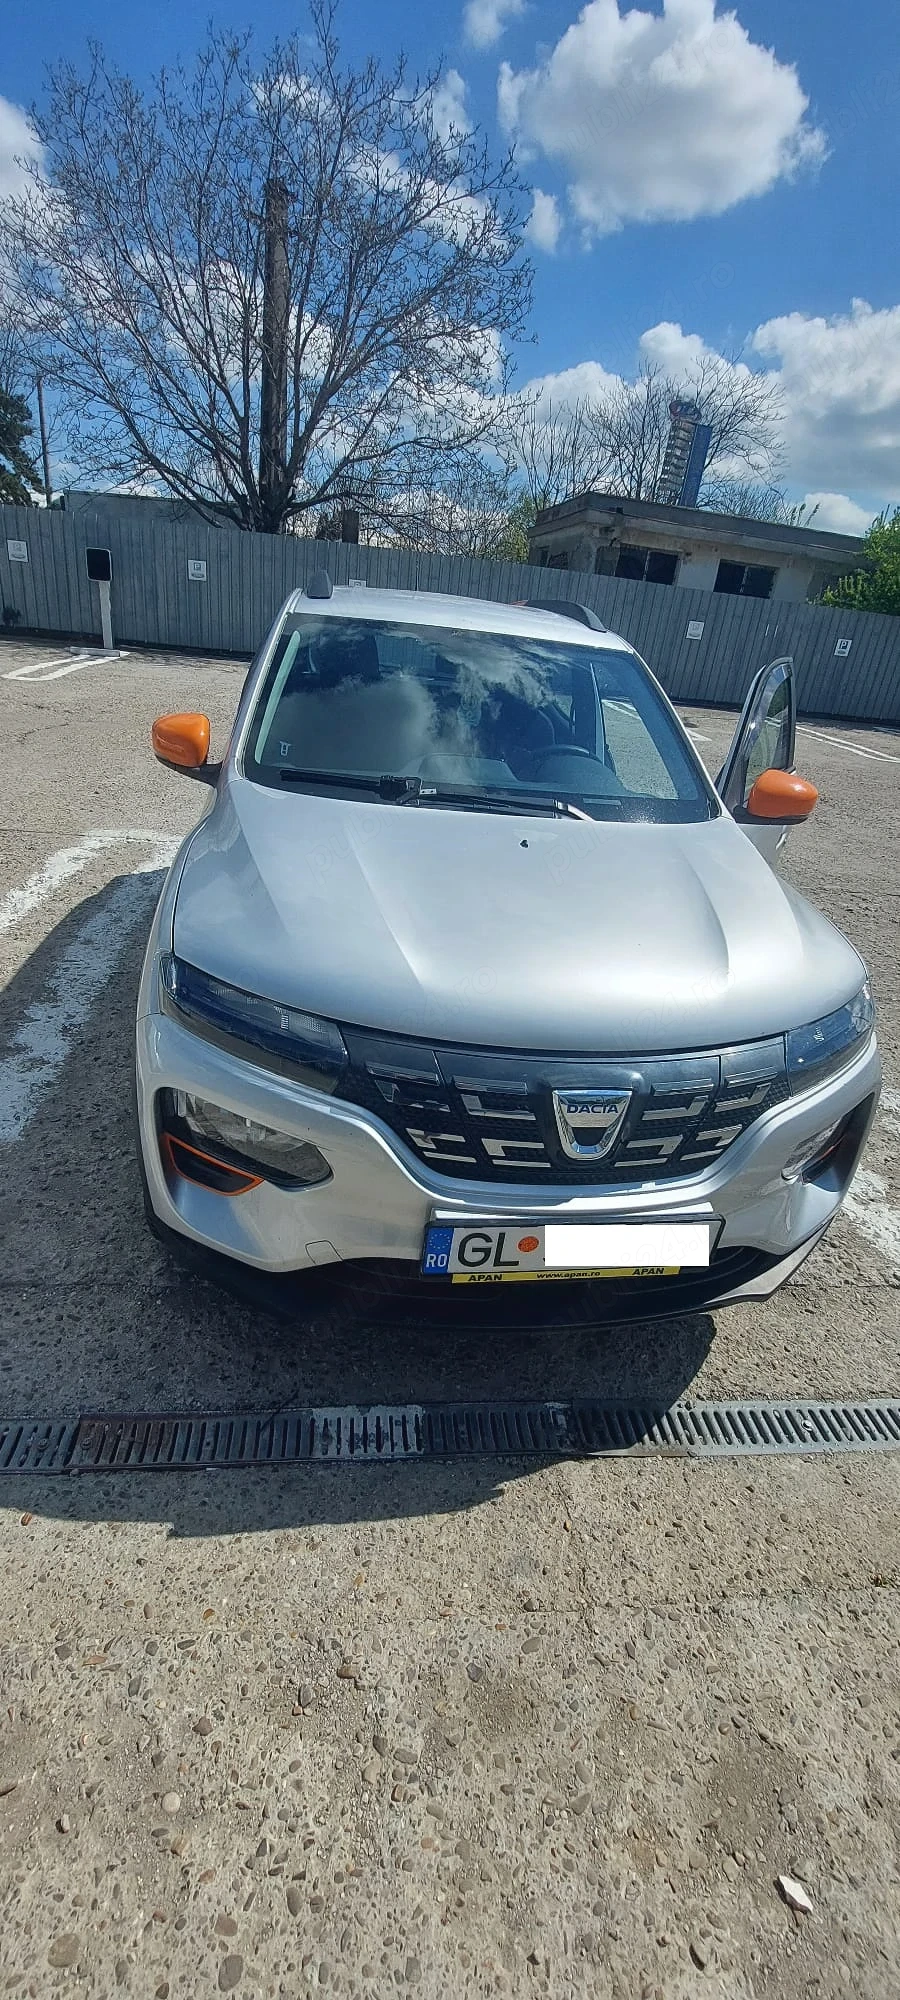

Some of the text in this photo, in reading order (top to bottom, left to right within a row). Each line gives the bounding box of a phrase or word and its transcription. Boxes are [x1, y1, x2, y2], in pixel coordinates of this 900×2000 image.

[566, 1103, 619, 1114] DACIA
[457, 1232, 520, 1267] GL
[425, 1253, 449, 1268] RO
[468, 1267, 665, 1282] APAN www.apan.ro APAN
